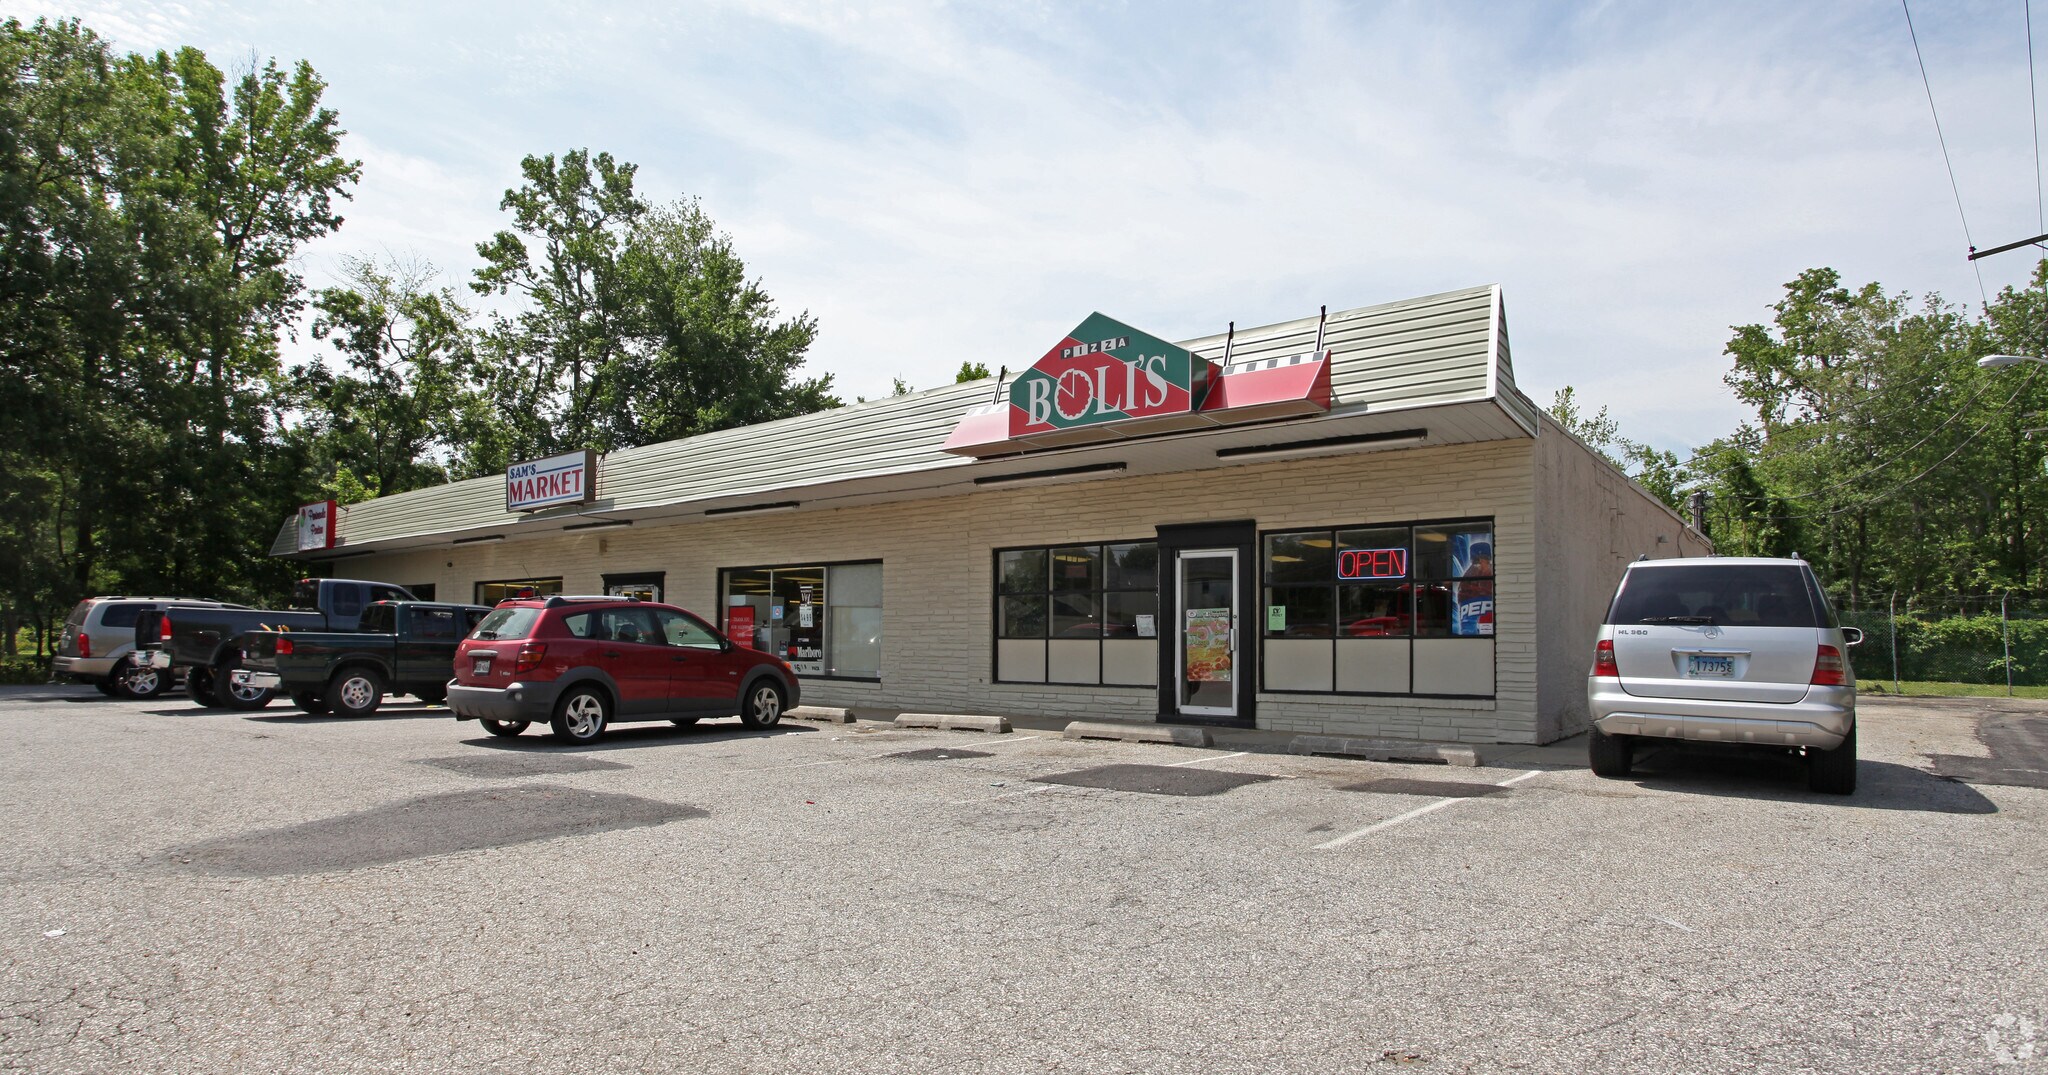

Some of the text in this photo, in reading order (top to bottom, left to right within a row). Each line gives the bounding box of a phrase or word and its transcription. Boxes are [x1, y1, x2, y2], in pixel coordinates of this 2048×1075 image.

[1063, 338, 1126, 359] PIZZA
[1025, 353, 1168, 427] BOLI'S
[510, 464, 536, 479] SAM'S
[510, 469, 583, 503] MARKET
[1340, 550, 1406, 577] OPEN
[797, 646, 822, 658] Marlboro
